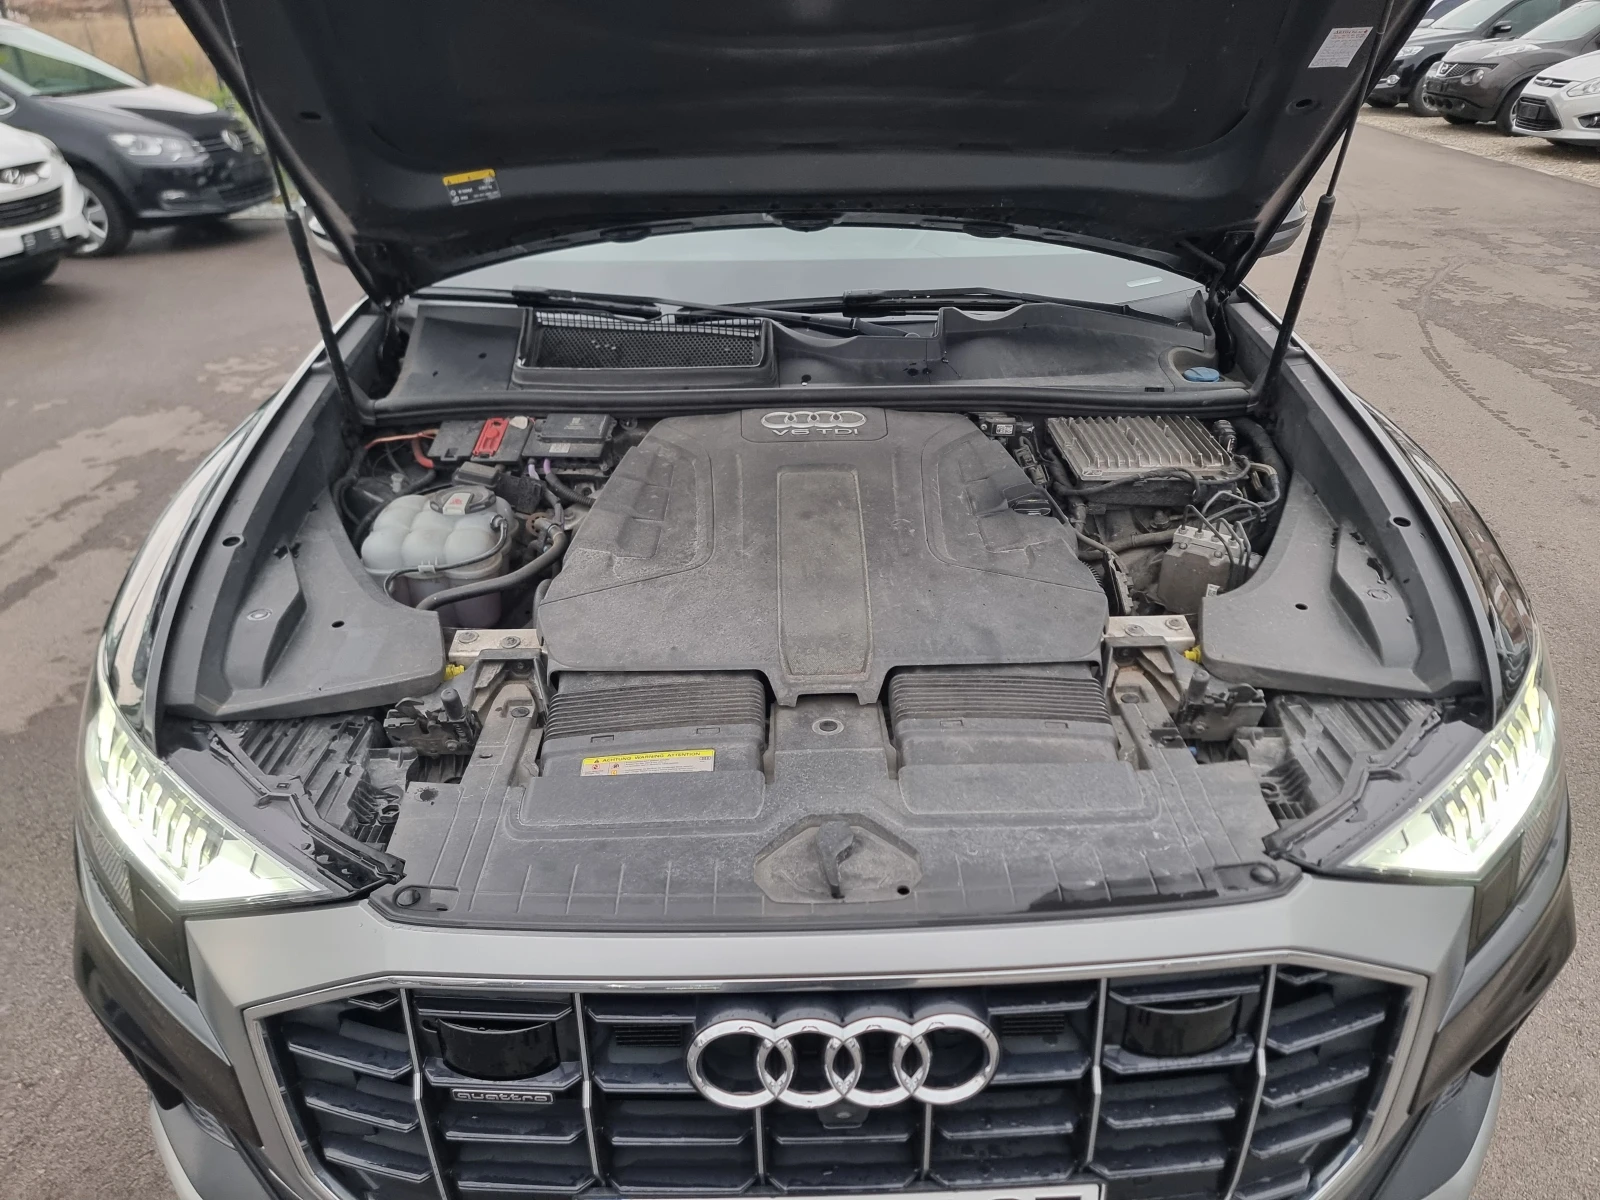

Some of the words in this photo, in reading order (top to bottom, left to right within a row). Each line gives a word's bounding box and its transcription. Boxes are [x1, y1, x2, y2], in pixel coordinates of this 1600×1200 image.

[772, 428, 810, 436] V6
[816, 428, 859, 436] TDI
[457, 1092, 548, 1102] quattro
